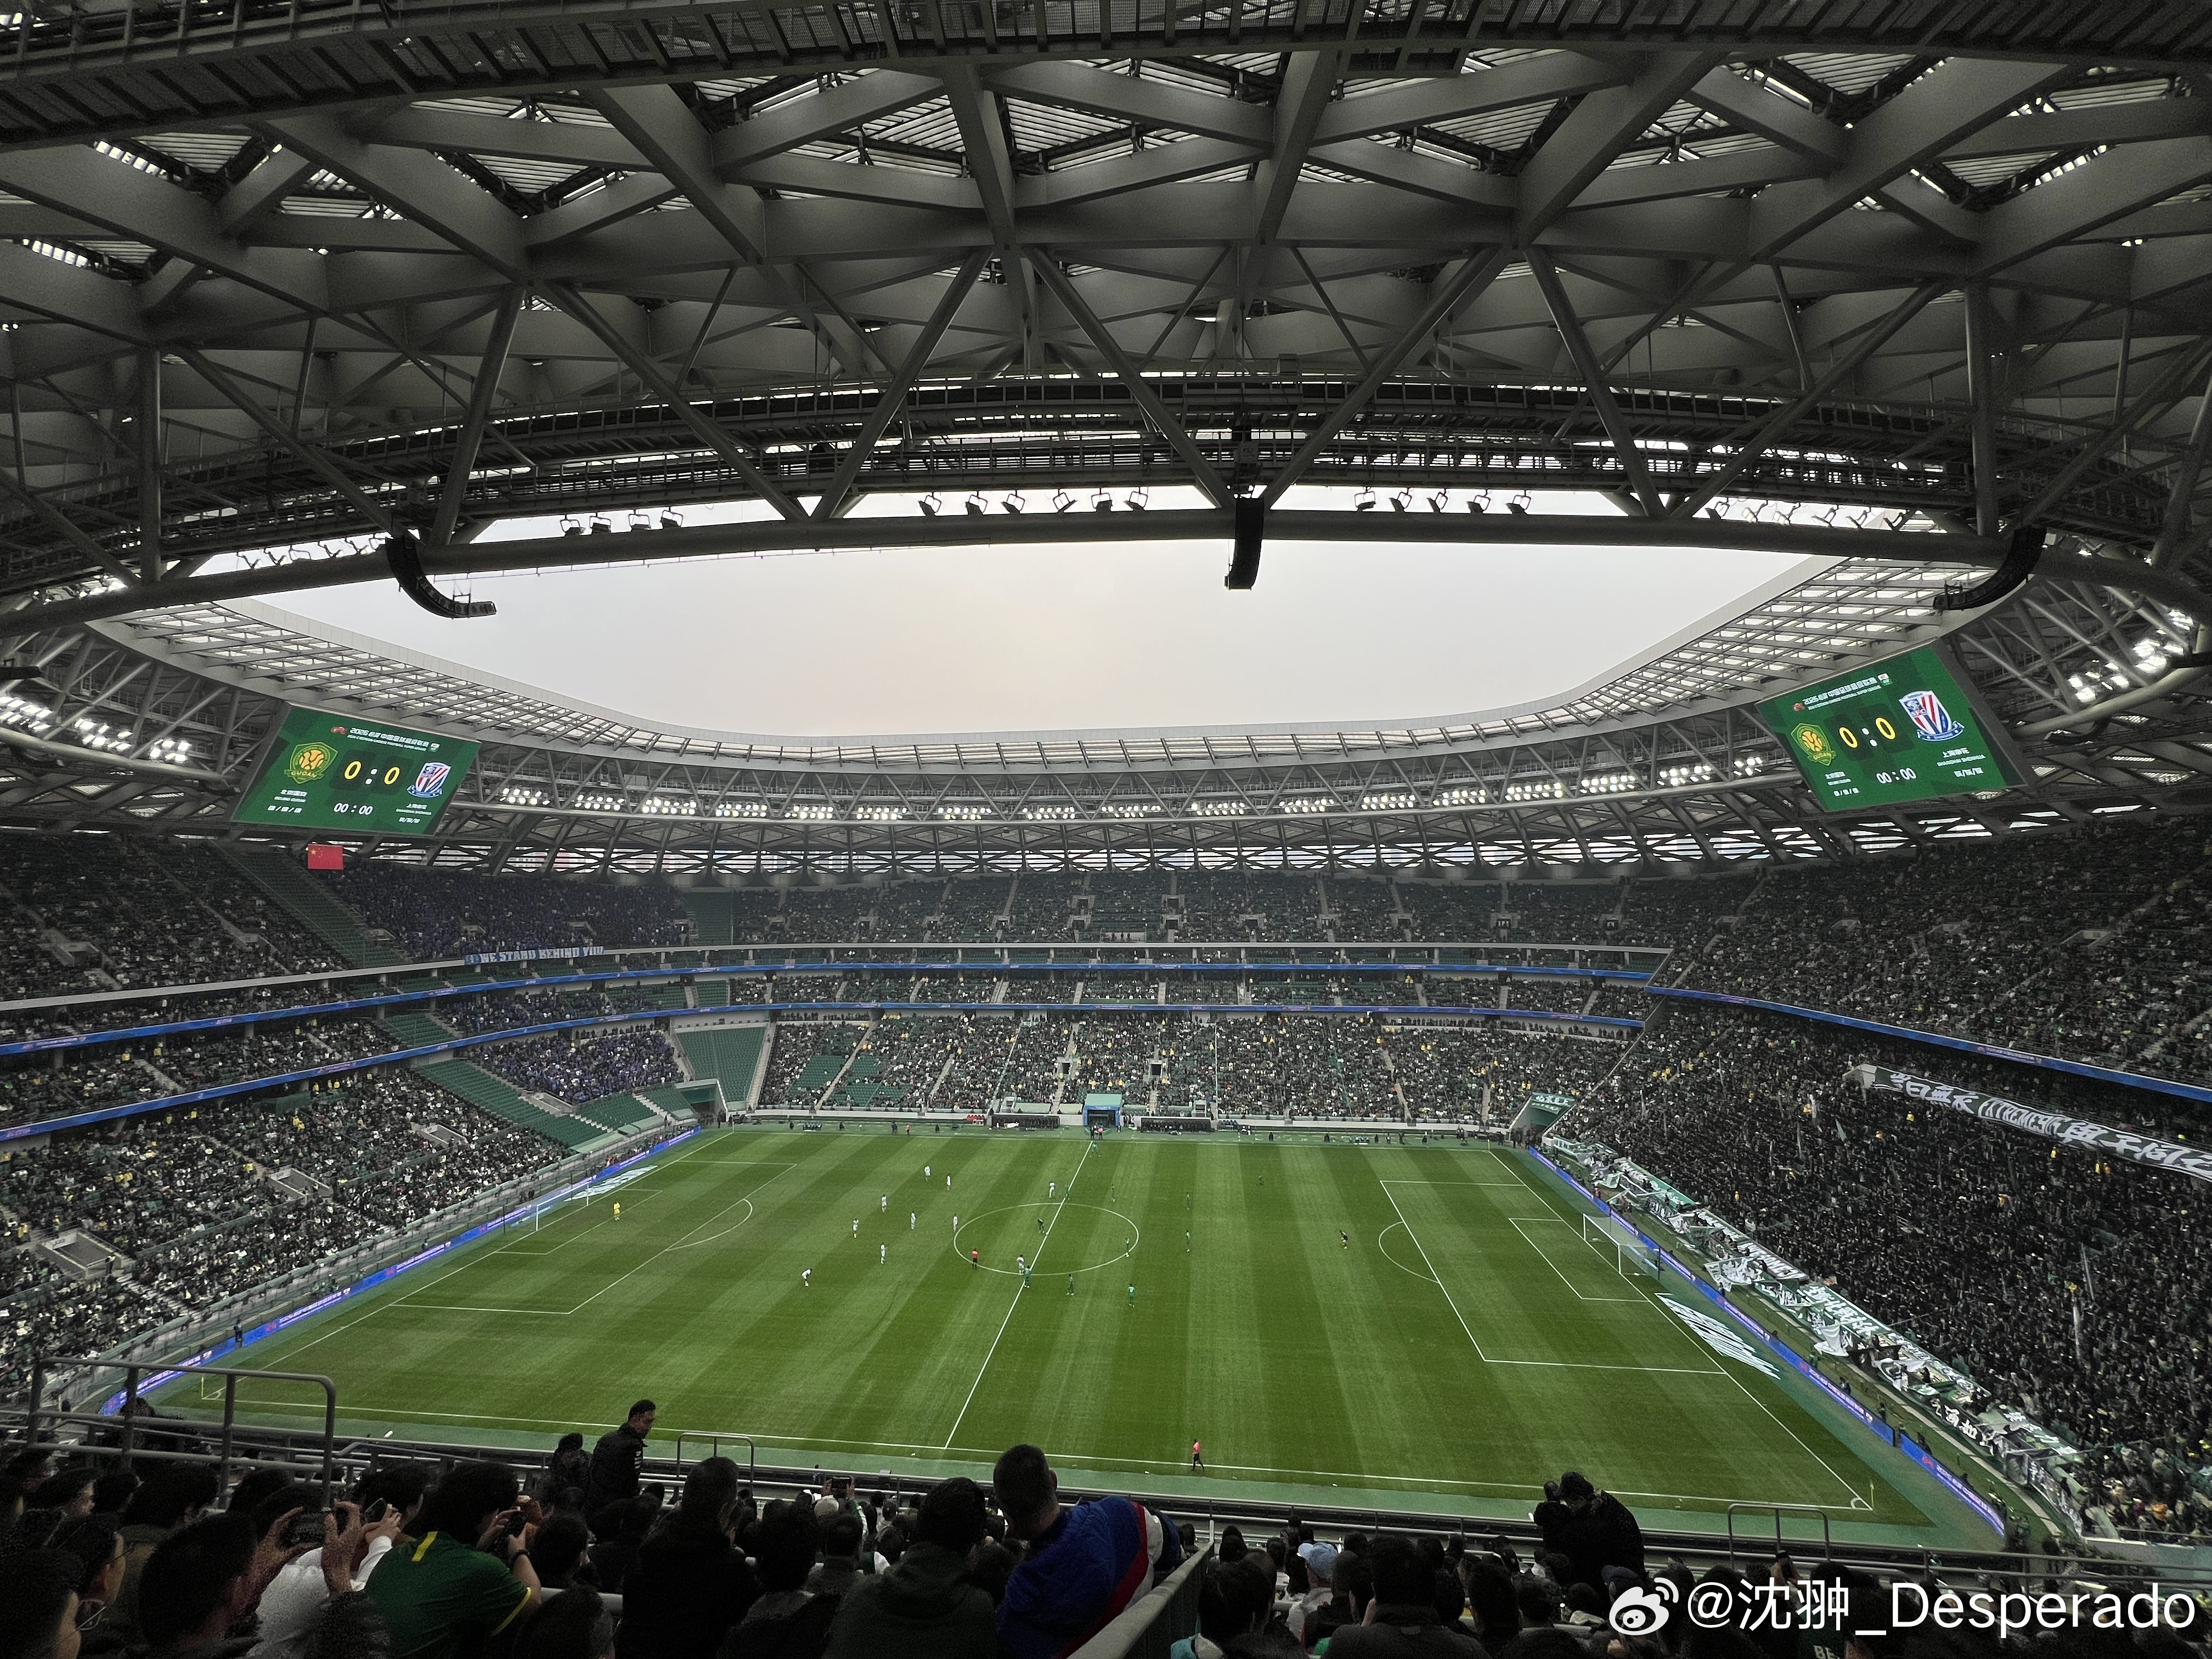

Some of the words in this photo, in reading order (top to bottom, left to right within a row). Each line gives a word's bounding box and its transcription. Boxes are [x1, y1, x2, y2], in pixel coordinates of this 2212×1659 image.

[1839, 727, 1858, 748] 0
[1875, 717, 1896, 740] 0
[345, 760, 362, 780] 0
[384, 766, 400, 785] 0
[499, 950, 536, 962] STAND
[539, 947, 580, 960] BEHIND
